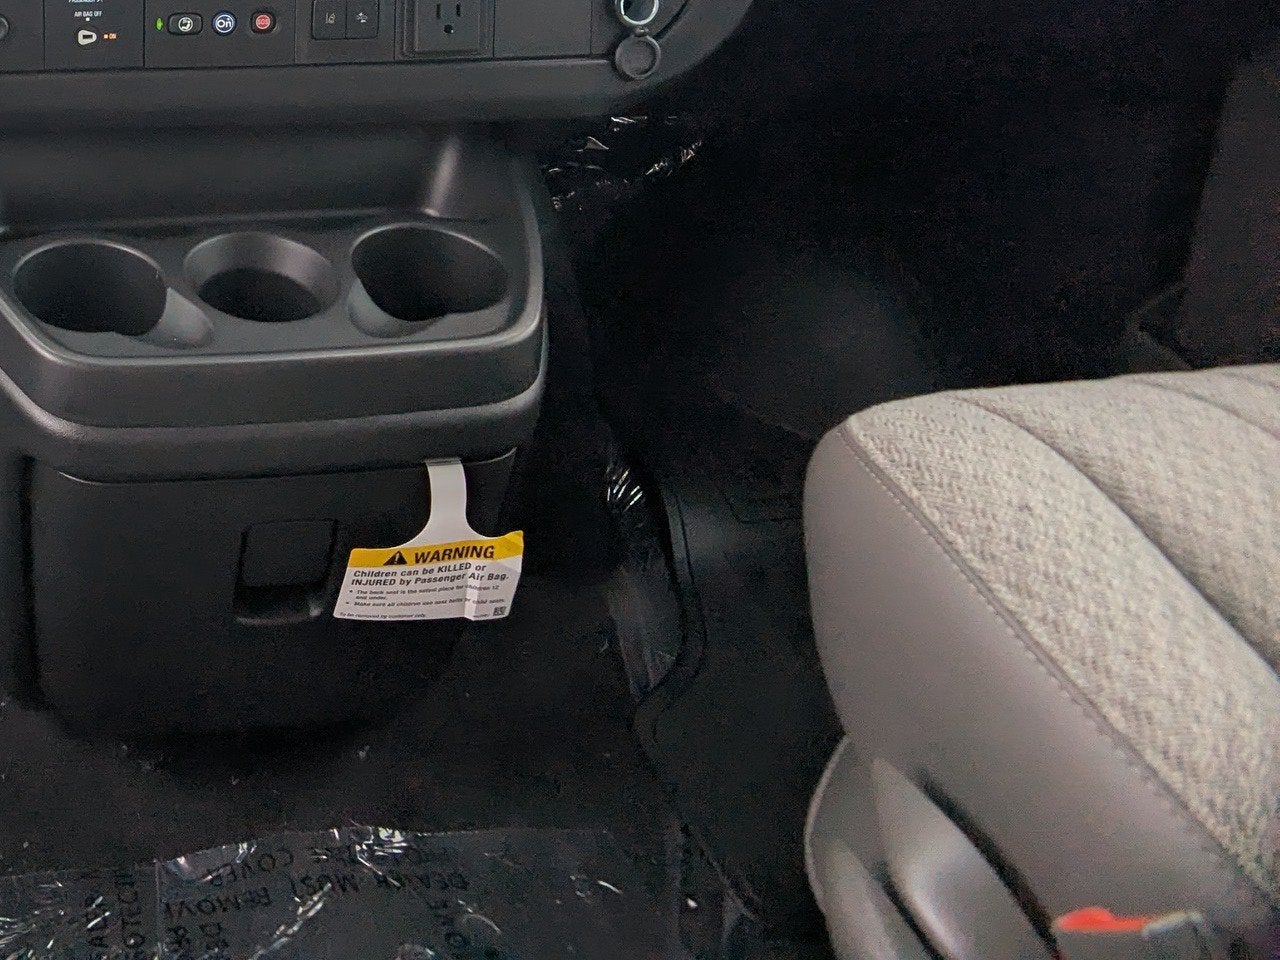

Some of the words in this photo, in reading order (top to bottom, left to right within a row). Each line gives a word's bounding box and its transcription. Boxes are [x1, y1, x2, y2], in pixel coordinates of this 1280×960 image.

[216, 17, 232, 29] On
[414, 545, 495, 564] WARNING
[353, 570, 397, 578] Children
[422, 567, 434, 575] be
[437, 562, 472, 574] KILLED
[475, 564, 487, 572] or
[351, 578, 397, 587] INJURED
[399, 578, 411, 587] by
[414, 573, 467, 585] Passenger
[468, 572, 485, 581] Air
[487, 573, 509, 581] Bag.
[288, 872, 360, 896] MUST
